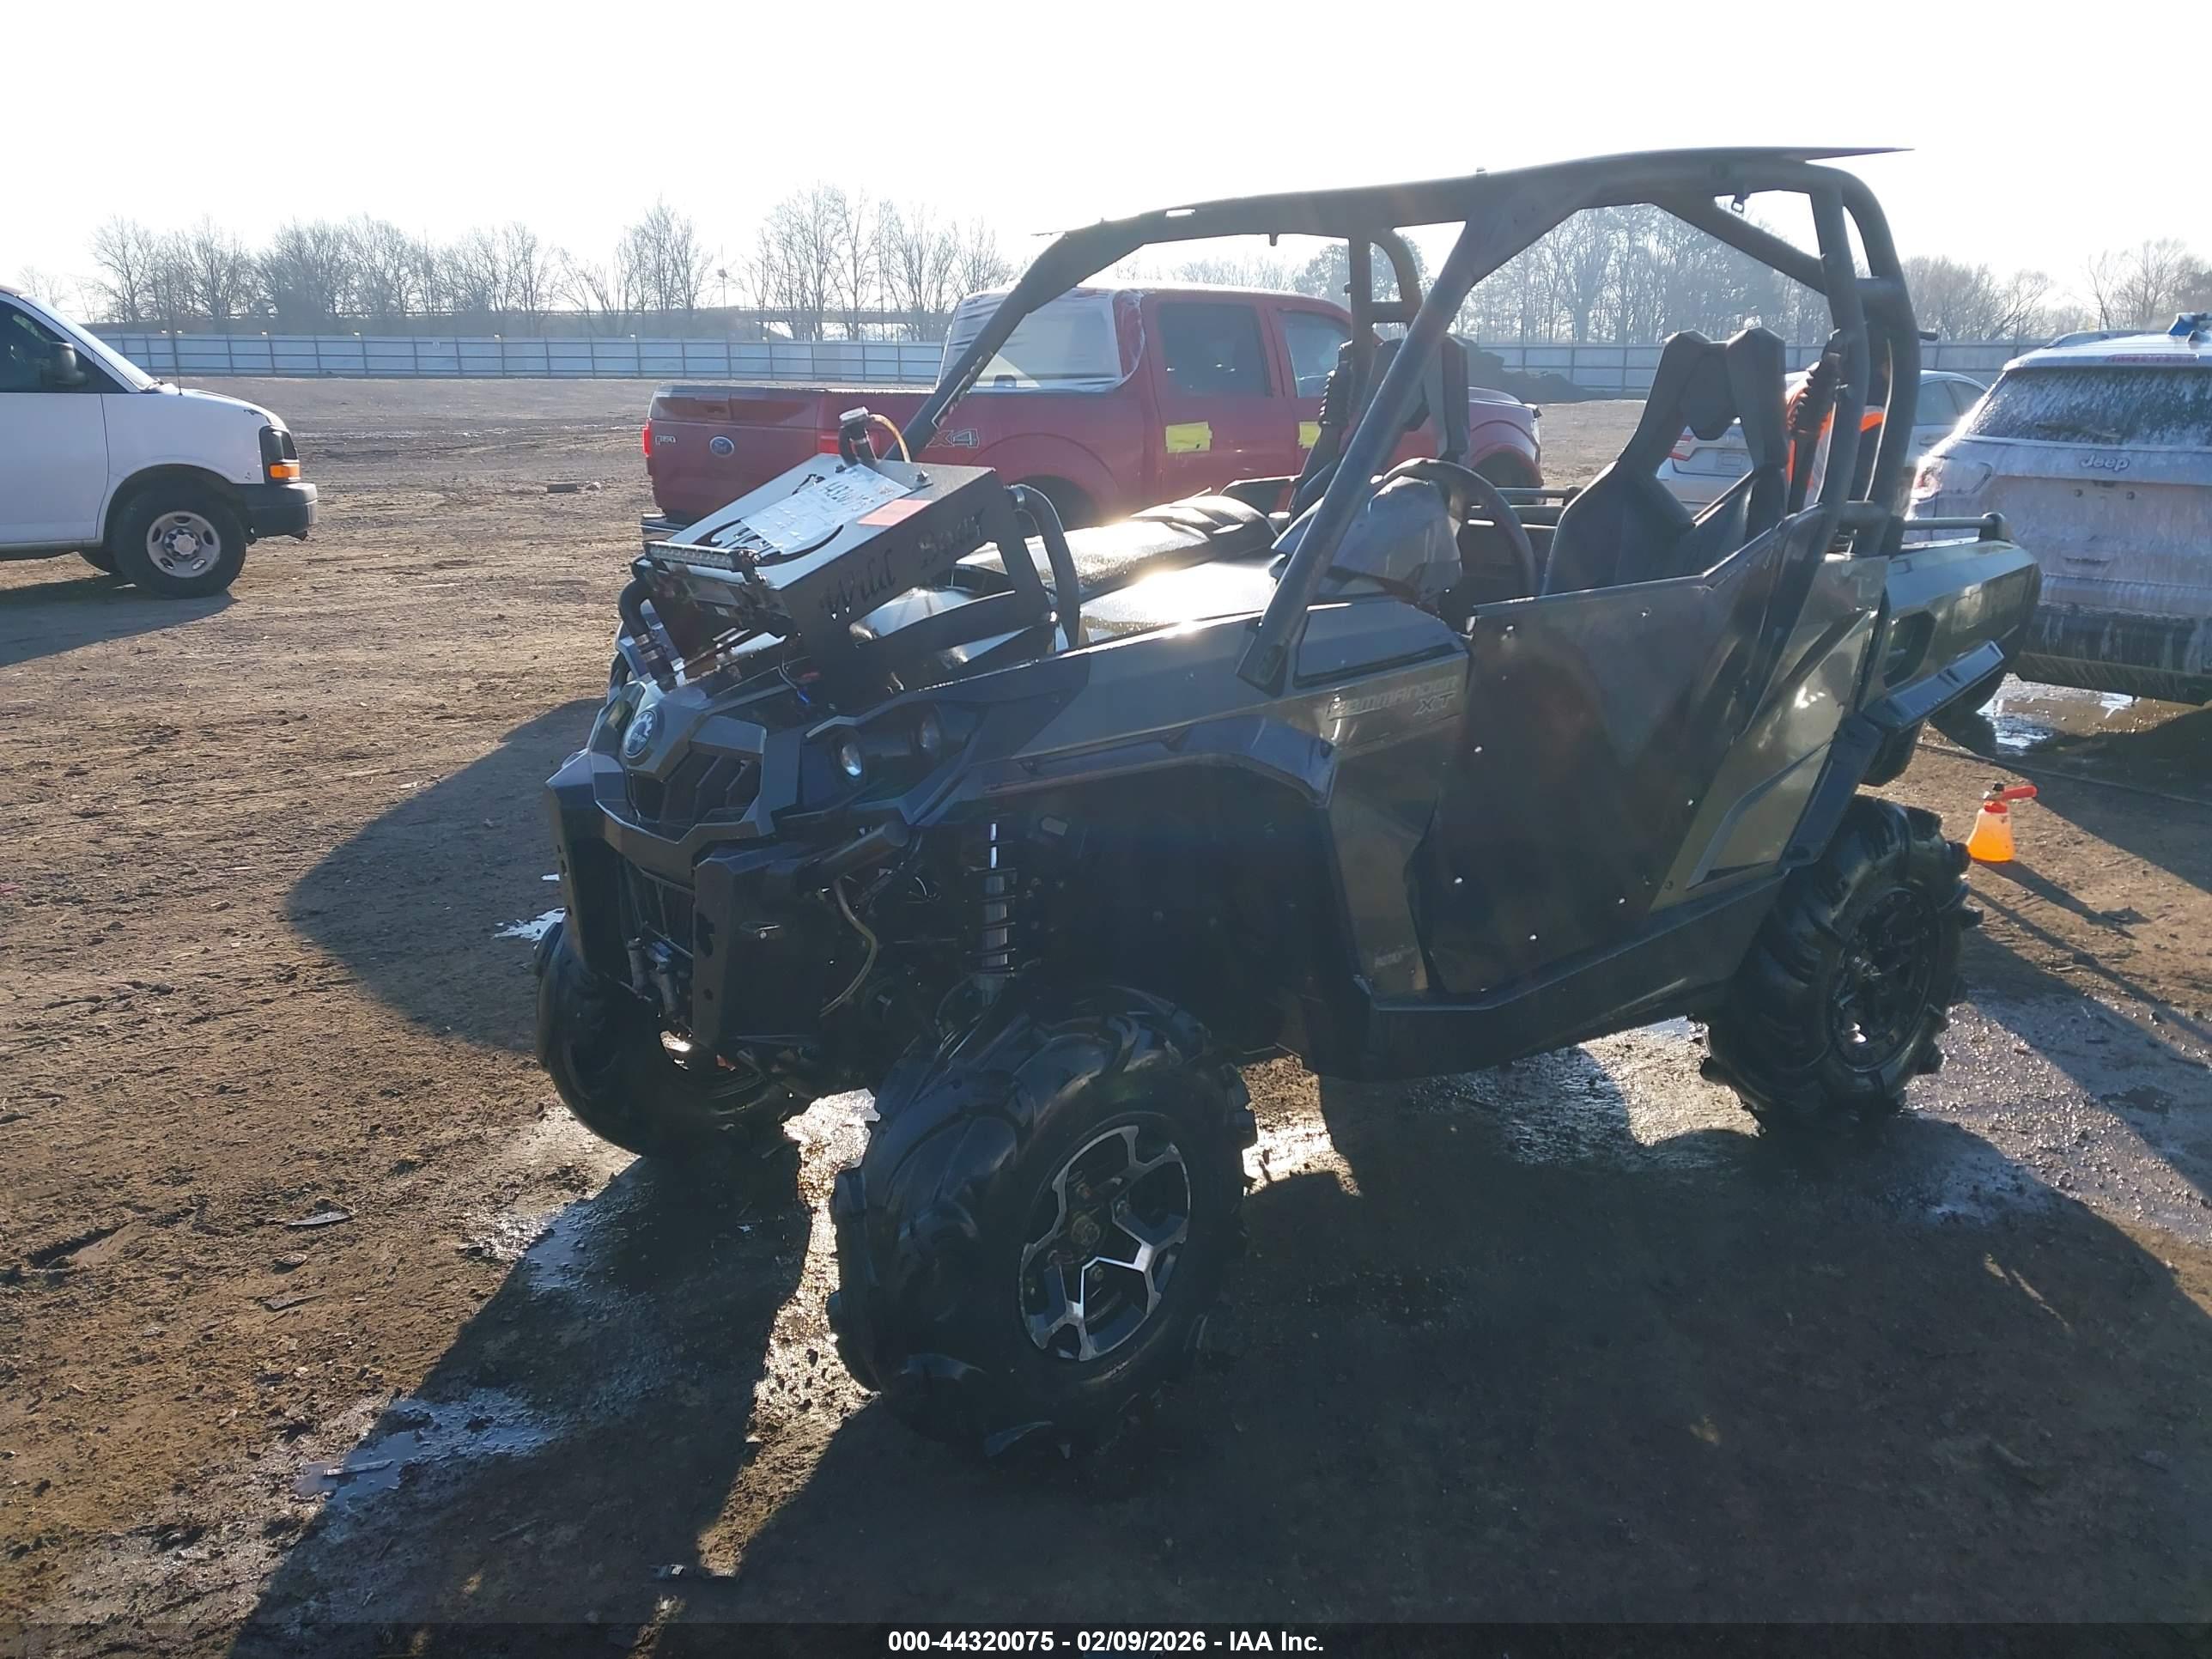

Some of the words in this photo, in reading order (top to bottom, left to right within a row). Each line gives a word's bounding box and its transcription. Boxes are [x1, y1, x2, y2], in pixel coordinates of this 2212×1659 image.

[925, 428, 980, 449] X4
[2080, 453, 2130, 471] Jeep
[818, 547, 897, 621] Wild
[1413, 690, 1458, 716] XT
